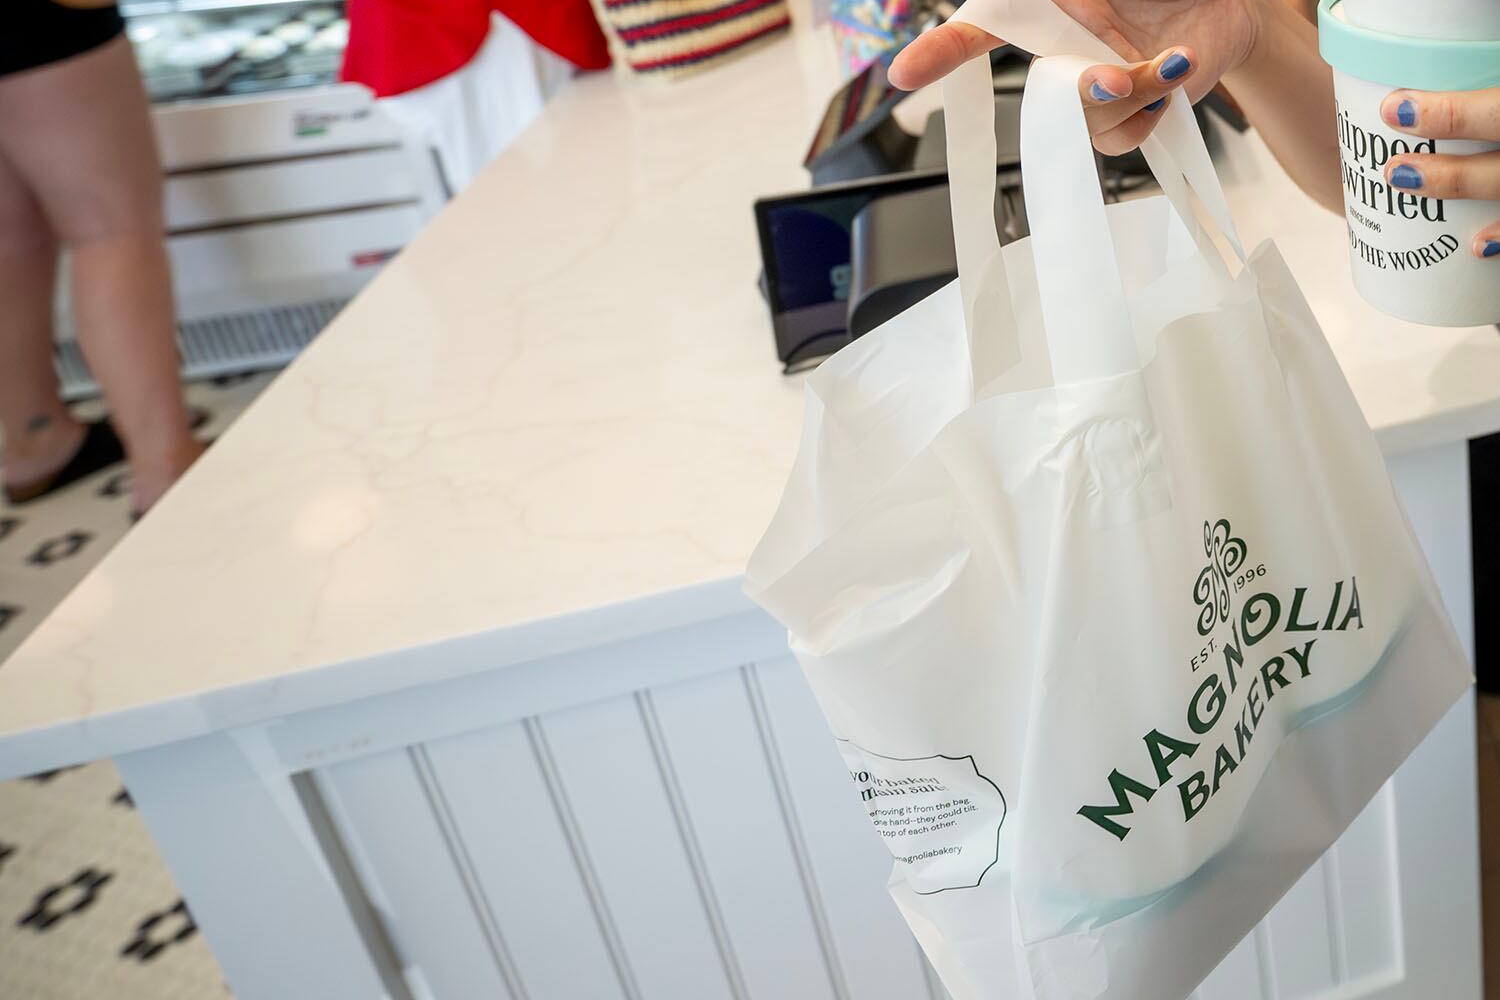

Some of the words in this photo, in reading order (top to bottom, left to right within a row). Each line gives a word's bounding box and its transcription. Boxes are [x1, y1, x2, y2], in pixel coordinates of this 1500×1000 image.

[1358, 238, 1387, 269] THE
[1387, 234, 1459, 272] WORLD
[1233, 563, 1267, 594] 1996
[1191, 637, 1218, 673] EST.
[1076, 575, 1364, 842] MAGNOLIA
[1176, 638, 1318, 823] BAKERY
[913, 804, 934, 814] from
[935, 802, 951, 811] the
[937, 808, 962, 819] could
[882, 829, 897, 838] top
[897, 828, 906, 836] of
[907, 825, 929, 835] each
[930, 819, 958, 832] other.
